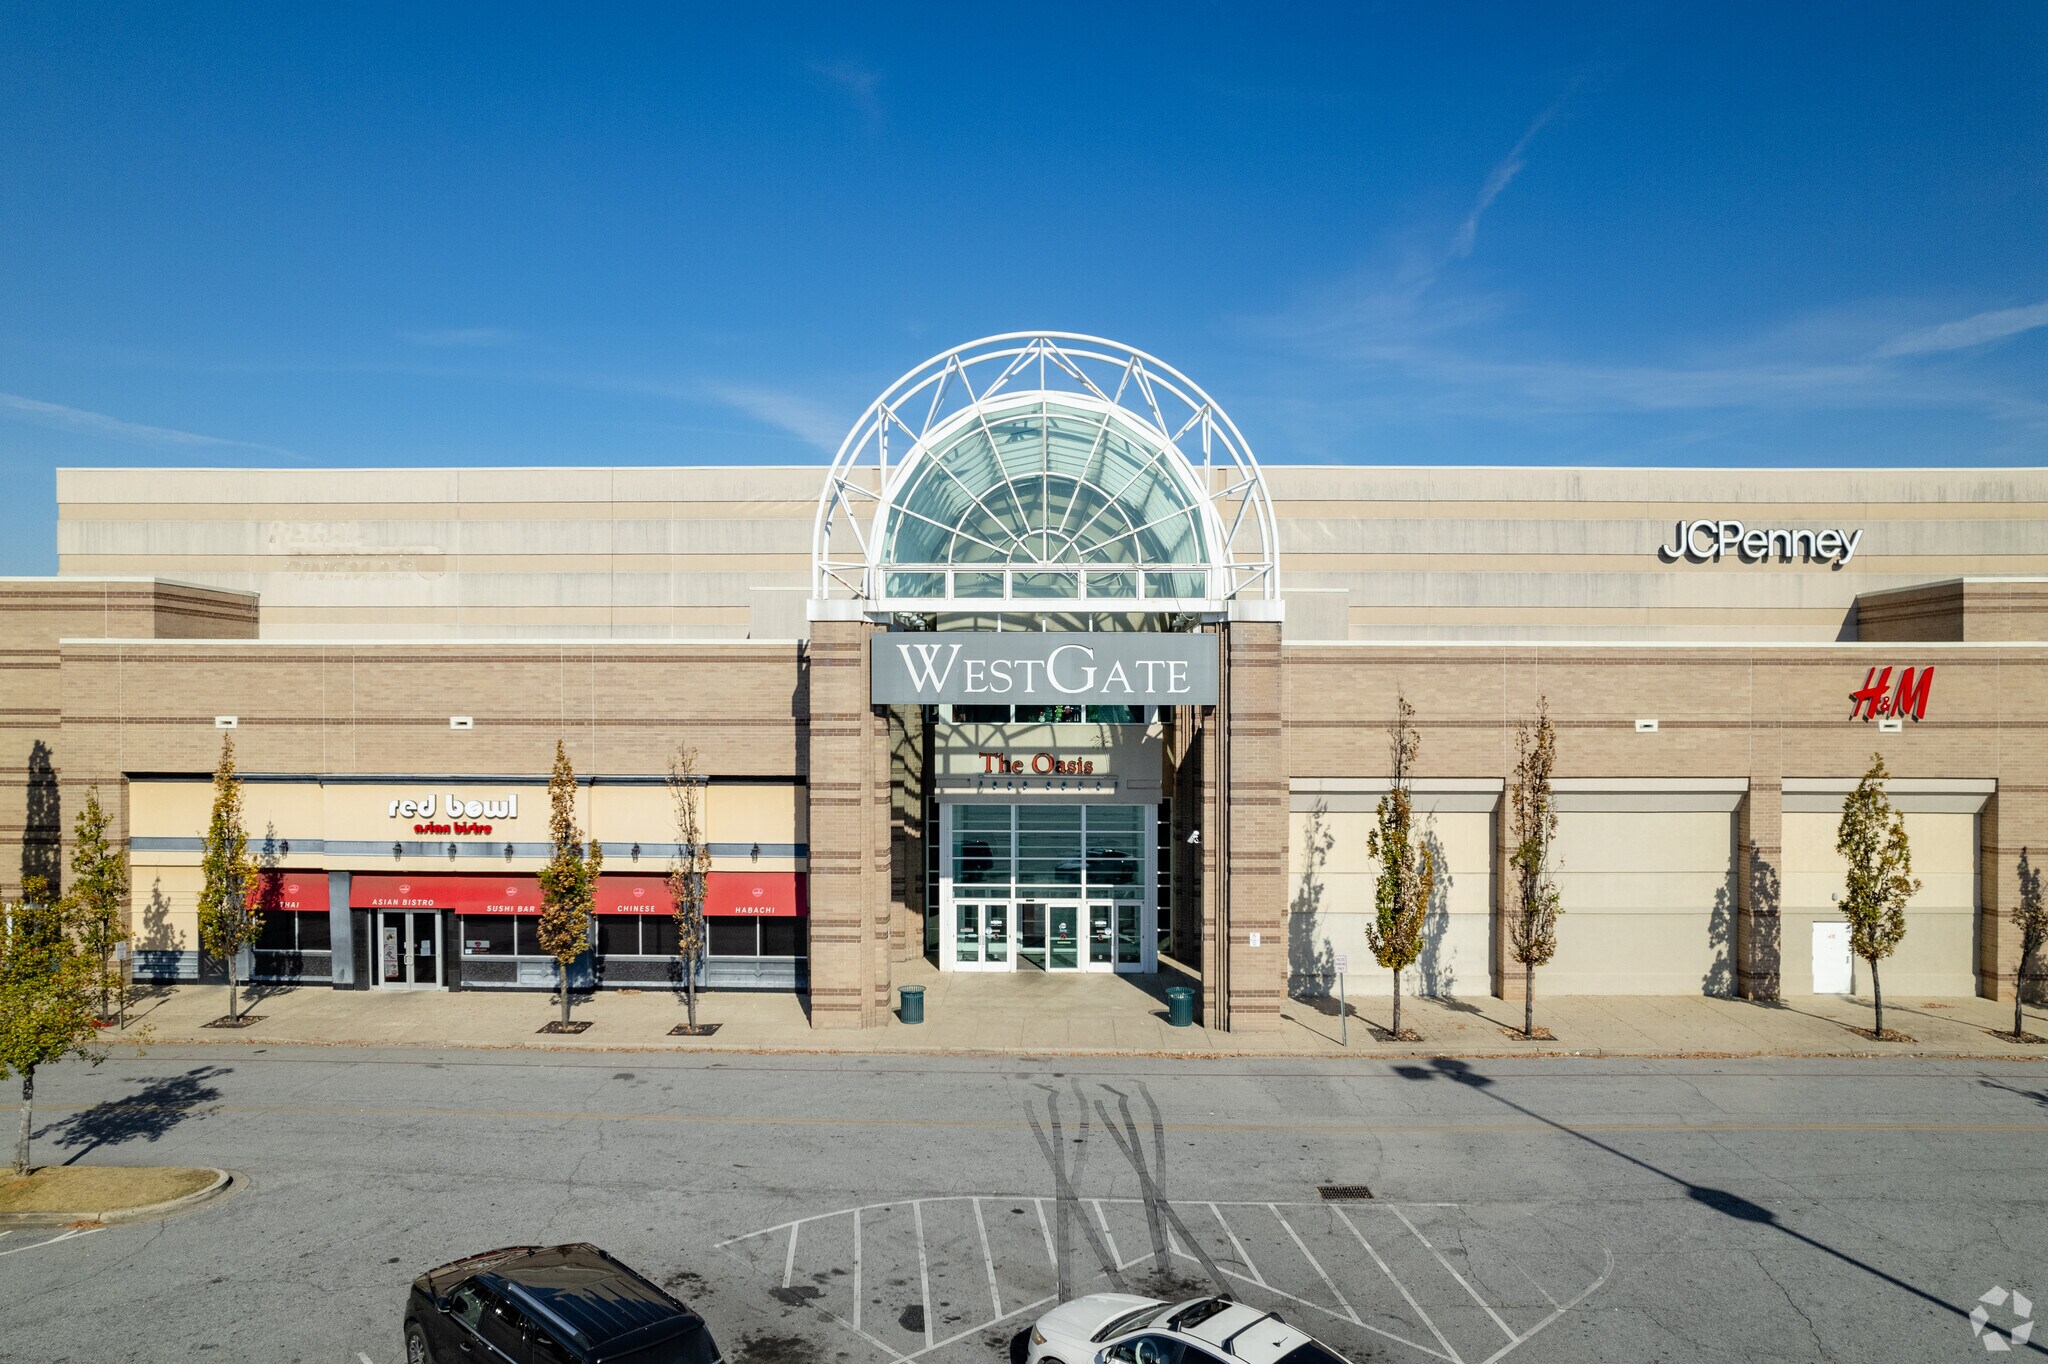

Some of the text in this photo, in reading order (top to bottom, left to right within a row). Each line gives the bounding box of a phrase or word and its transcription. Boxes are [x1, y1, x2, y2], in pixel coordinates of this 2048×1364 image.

[1662, 519, 1864, 565] JCPenney
[1851, 666, 1935, 720] H&M
[979, 752, 1094, 774] The Oasis
[388, 794, 518, 818] red bowl
[413, 821, 493, 835] asian bistro
[372, 898, 399, 906] ASIAN
[517, 905, 535, 913] BAR
[735, 906, 775, 914] HABACHI
